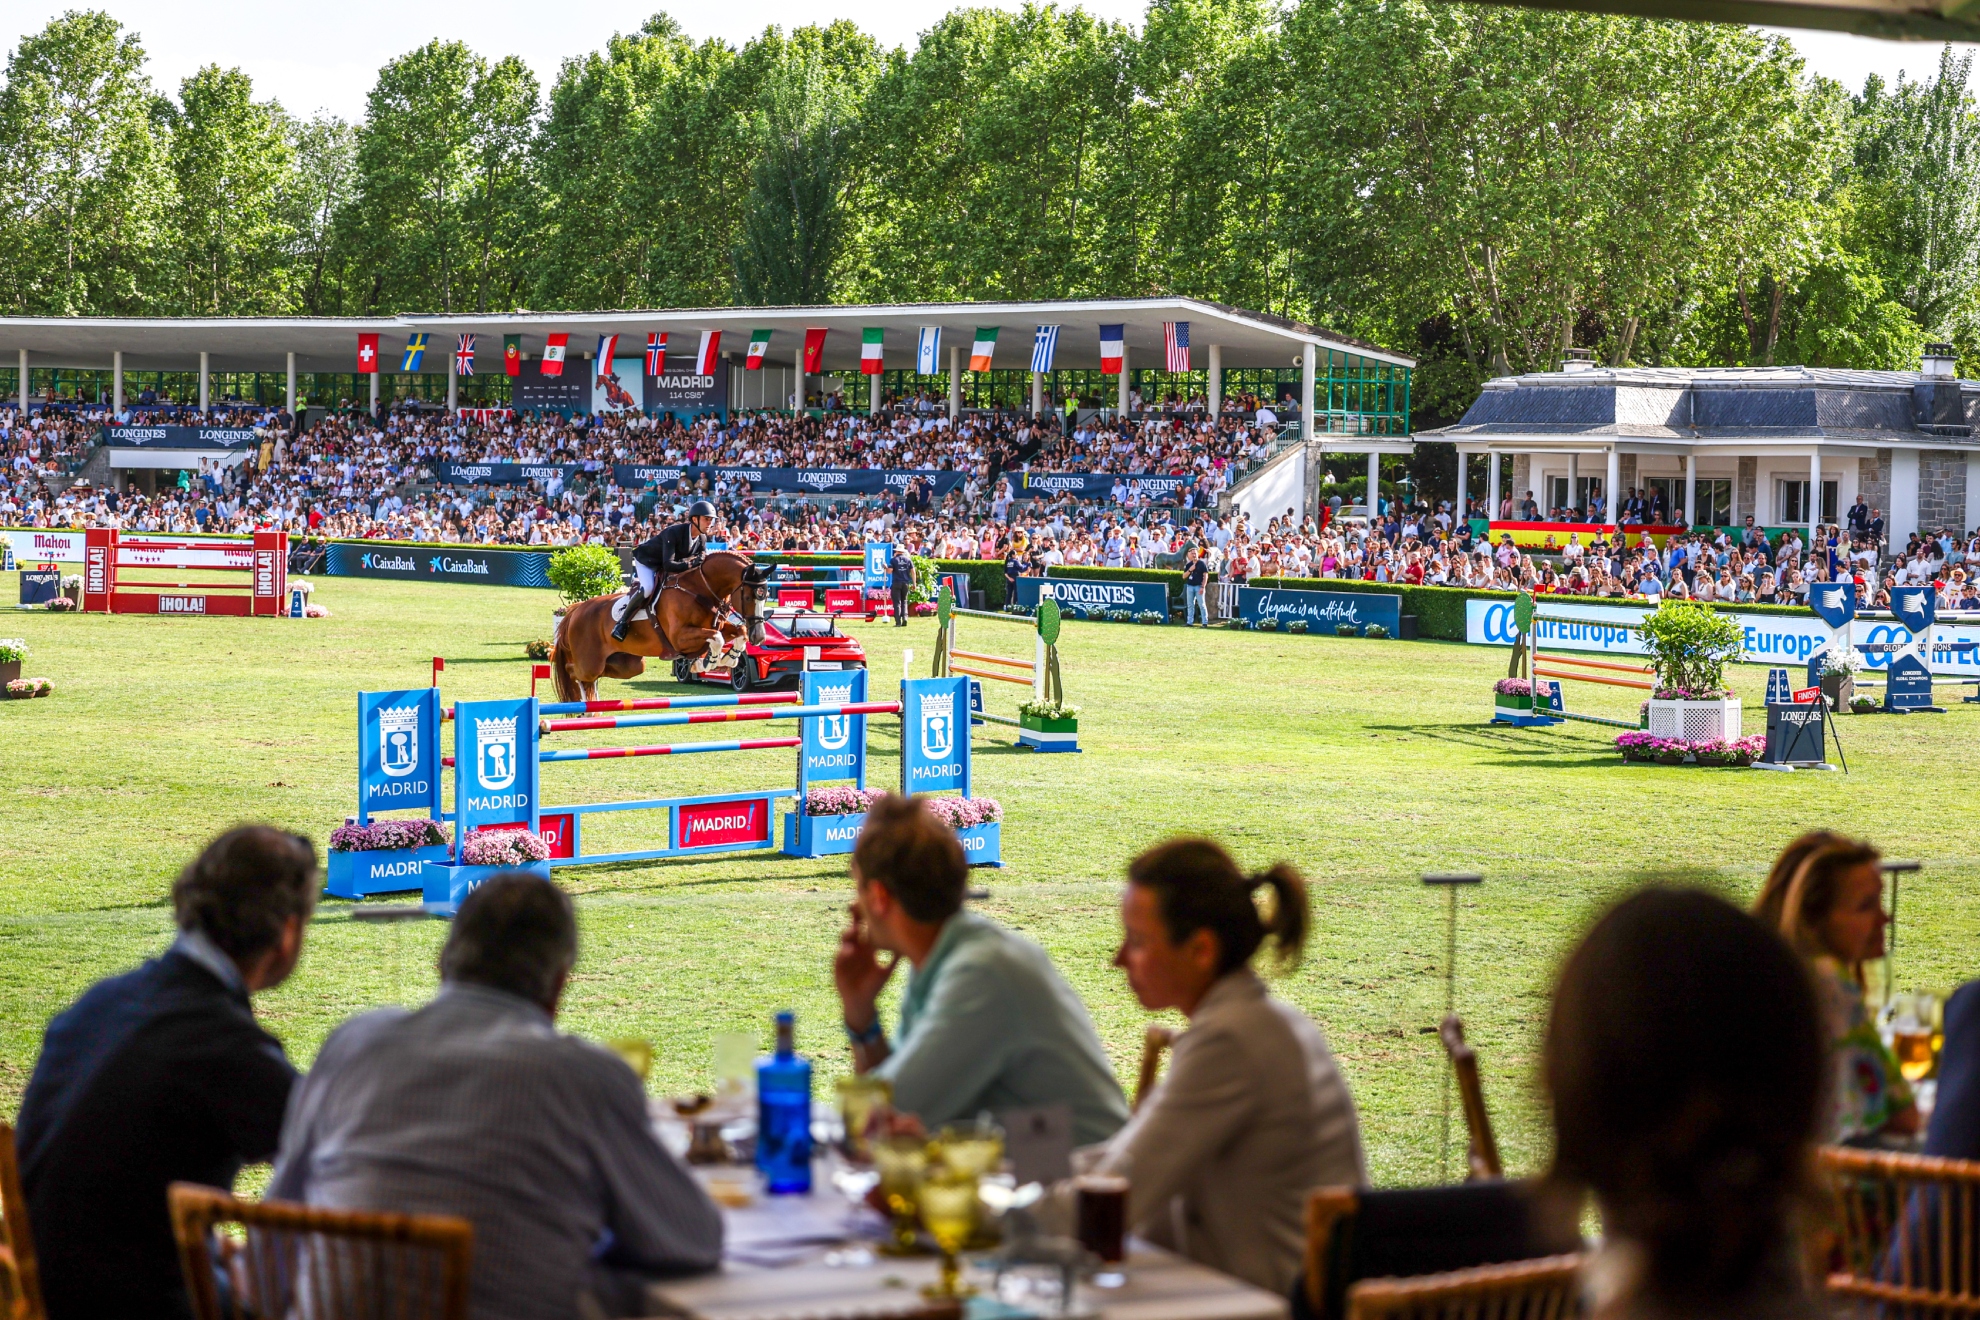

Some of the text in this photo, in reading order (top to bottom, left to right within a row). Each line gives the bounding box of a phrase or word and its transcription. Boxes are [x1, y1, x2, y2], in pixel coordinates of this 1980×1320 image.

[657, 376, 714, 388] MADRID
[111, 428, 166, 438] LONGINES
[199, 430, 255, 440] LONGINES
[451, 466, 491, 476] LONGINES
[797, 472, 847, 484] LONGINES
[885, 474, 936, 486] LONGS
[1028, 477, 1084, 488] LONGINES
[34, 534, 70, 549] Mahou
[373, 554, 416, 570] CaixaBank
[443, 557, 489, 574] CaixaBank
[88, 549, 104, 592] ¡HOLA!
[258, 552, 272, 594] ¡HOLA!
[161, 597, 203, 612] ¡HOLA!
[1258, 591, 1297, 619] Elegance
[1298, 598, 1306, 616] is
[1308, 605, 1320, 620] an
[972, 699, 977, 707] B
[1552, 698, 1558, 706] 8
[1798, 690, 1816, 701] FINISH
[809, 754, 856, 768] MADRID
[912, 764, 962, 780] MADRID
[369, 781, 428, 798] MADRID
[468, 794, 528, 811] MADRID
[826, 826, 864, 841] MADR
[370, 860, 432, 878] MADRI
